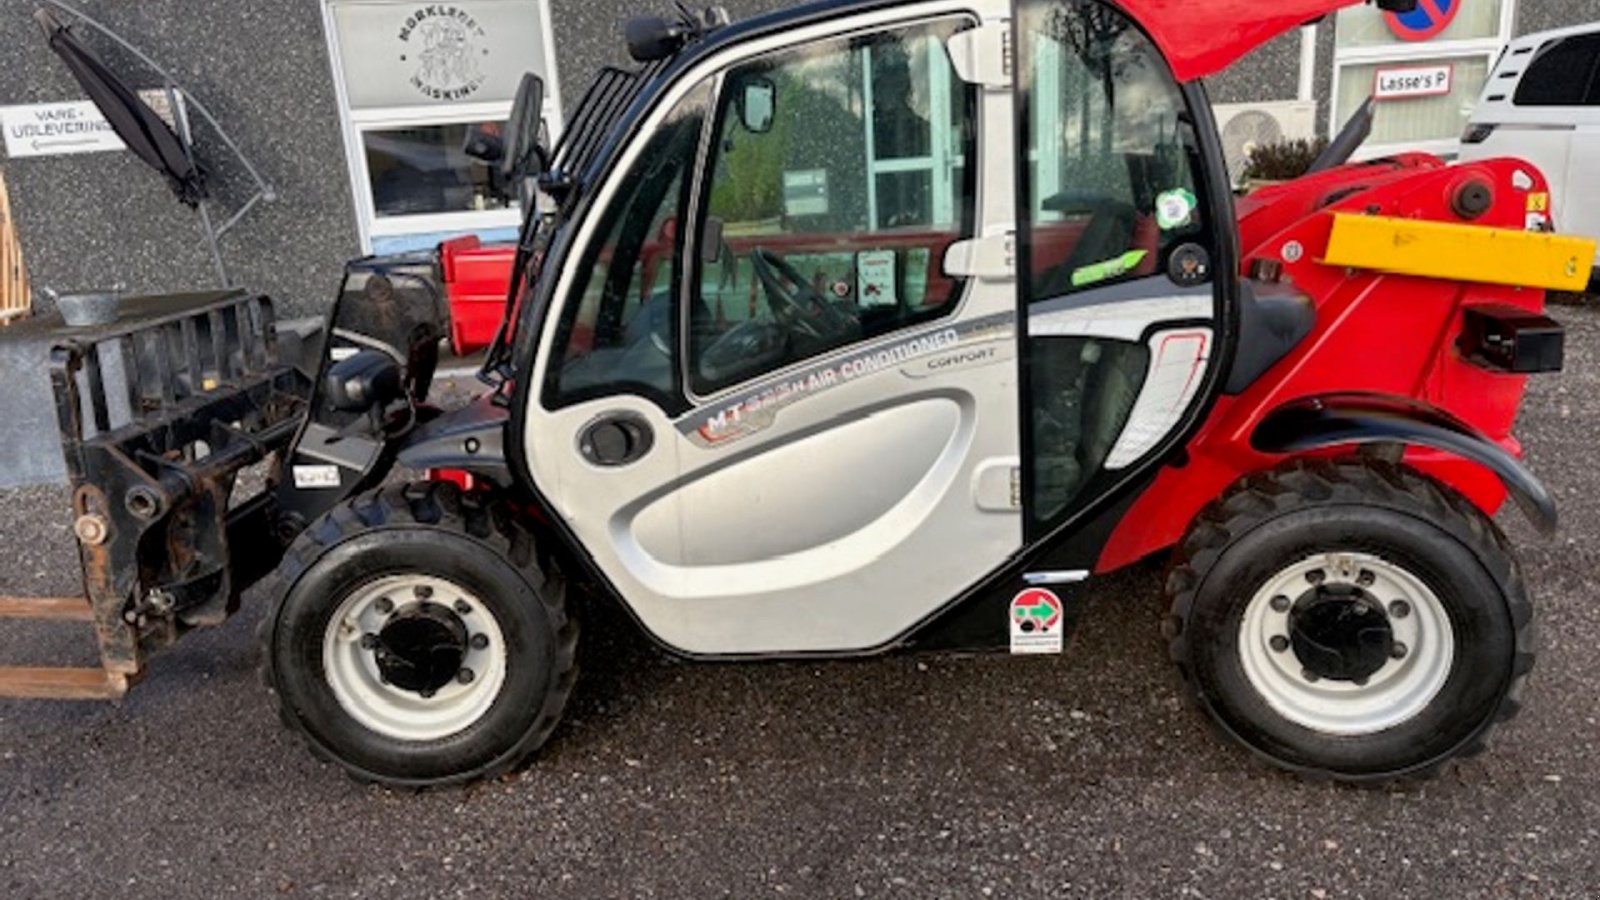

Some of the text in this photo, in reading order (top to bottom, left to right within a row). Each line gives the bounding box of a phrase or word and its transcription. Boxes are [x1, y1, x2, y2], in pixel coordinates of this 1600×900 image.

[1380, 71, 1446, 92] Lasse's P
[808, 367, 837, 390] AIR
[841, 329, 959, 379] CONDITIONED
